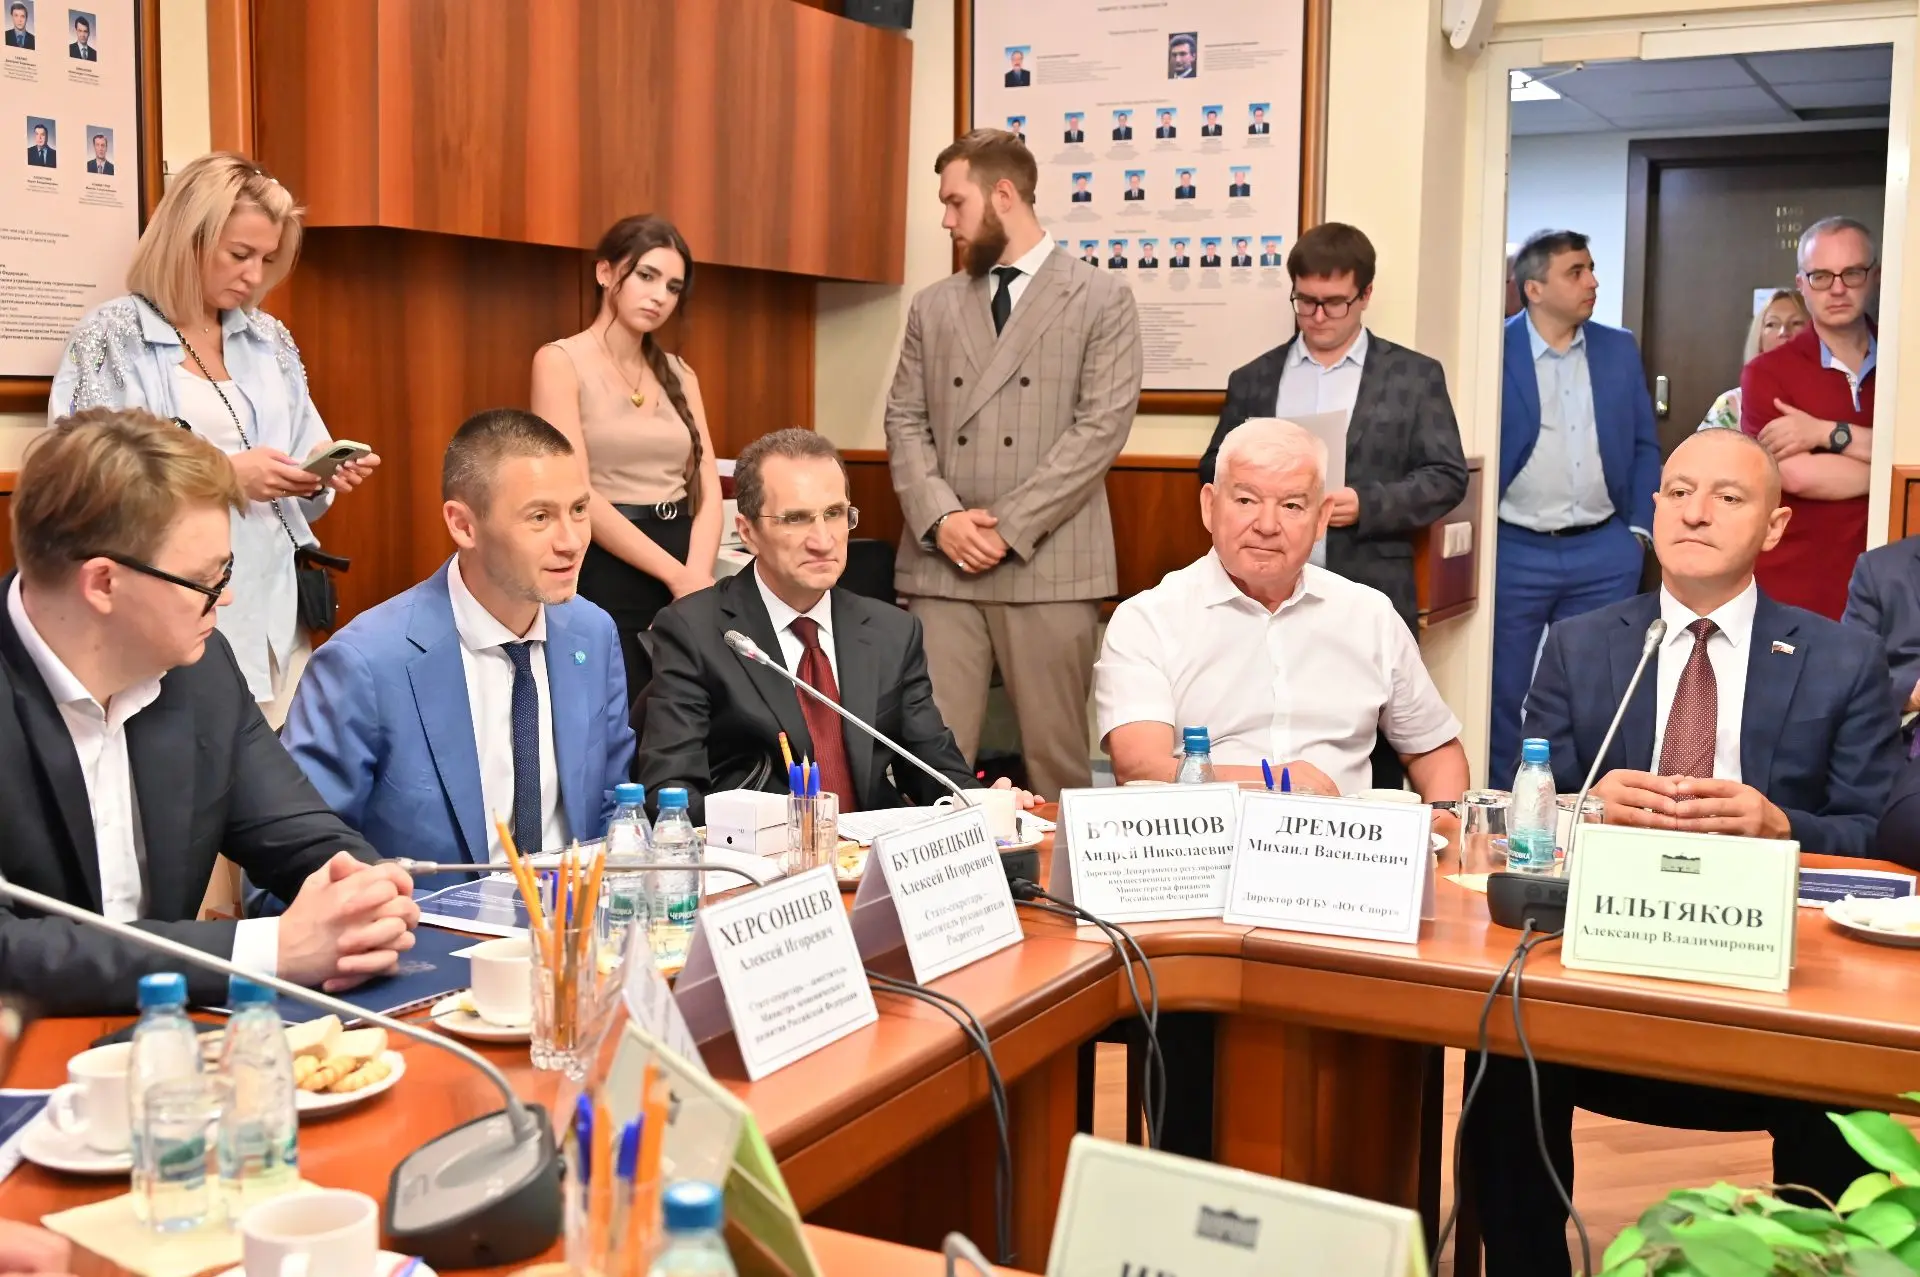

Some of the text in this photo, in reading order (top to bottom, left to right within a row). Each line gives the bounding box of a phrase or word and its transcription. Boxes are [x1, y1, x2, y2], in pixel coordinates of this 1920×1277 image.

[1275, 815, 1383, 841] ДРЕМОВ
[892, 822, 985, 872] БУТОВЕЦКИЙ
[1143, 845, 1234, 858] Николаевич
[1248, 838, 1408, 866] Михаил Васильевич
[900, 854, 994, 898] Алексей Игоревич
[1244, 892, 1293, 906] Директор
[1296, 897, 1327, 909] ФГБУ
[1594, 894, 1764, 928] ИЛЬТЯКОВ
[720, 889, 832, 949] ХЕРСОНЦЕВ
[740, 926, 834, 973] Алексей Игоревич
[1580, 924, 1775, 952] Александр Владимирович
